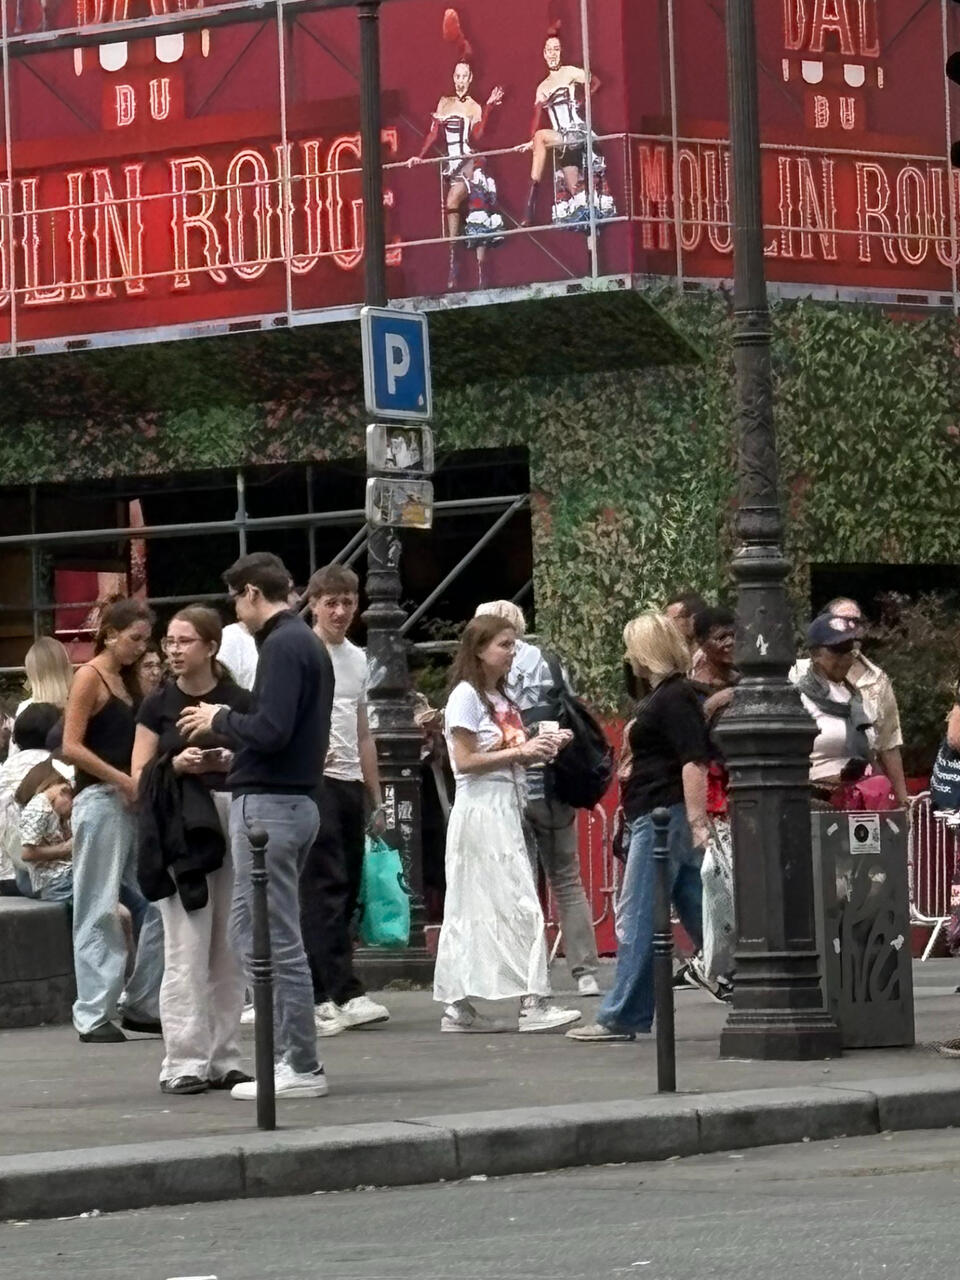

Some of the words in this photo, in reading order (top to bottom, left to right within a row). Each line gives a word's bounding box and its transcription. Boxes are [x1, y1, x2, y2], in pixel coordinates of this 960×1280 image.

[115, 78, 171, 126] DU
[815, 95, 855, 130] DU
[639, 145, 838, 260] MOUIN
[385, 332, 411, 395] P
